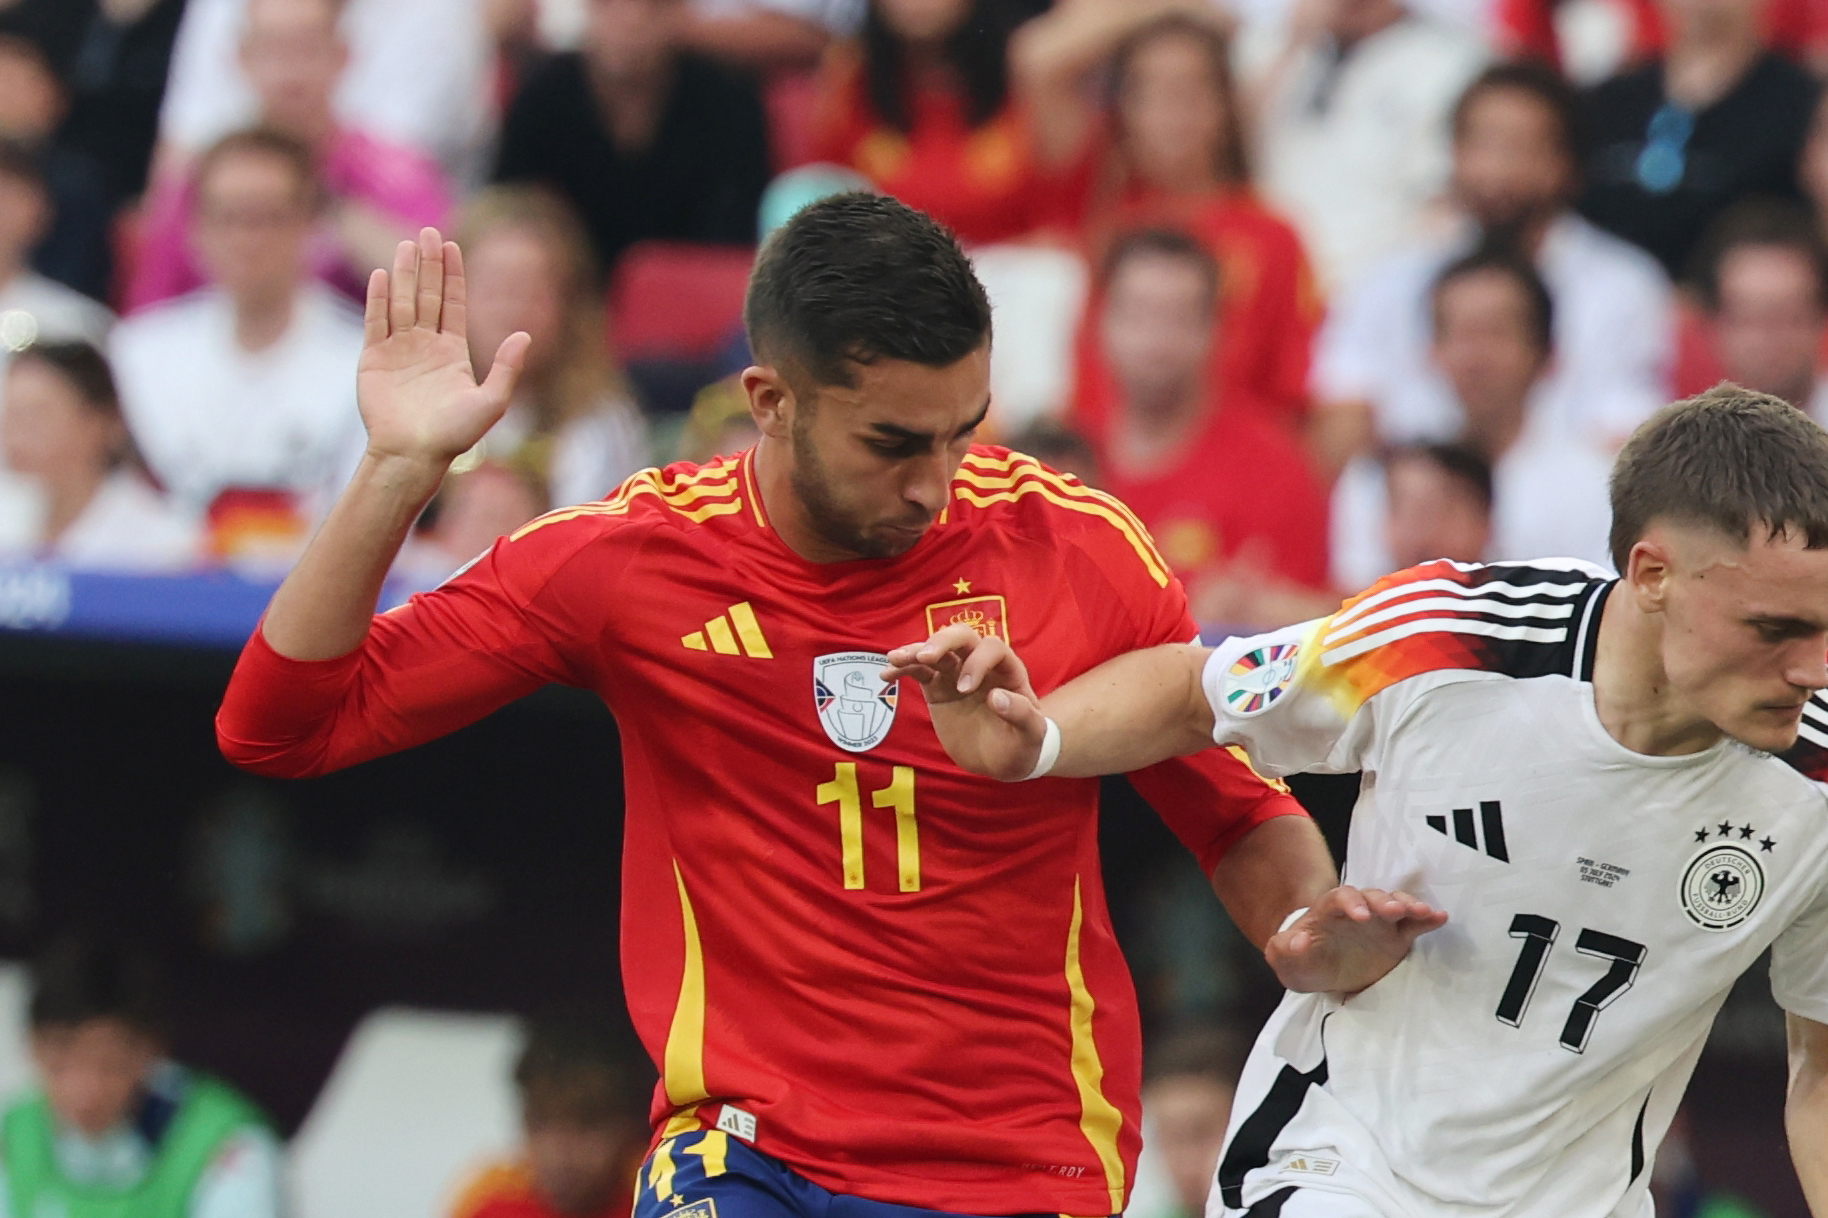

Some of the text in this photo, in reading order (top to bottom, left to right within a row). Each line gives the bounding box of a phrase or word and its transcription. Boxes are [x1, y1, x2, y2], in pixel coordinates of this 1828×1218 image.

[867, 655, 889, 664] LEAGU
[817, 761, 921, 892] 11
[1704, 856, 1751, 875] DEUTSCHER
[1495, 912, 1648, 1054] 17
